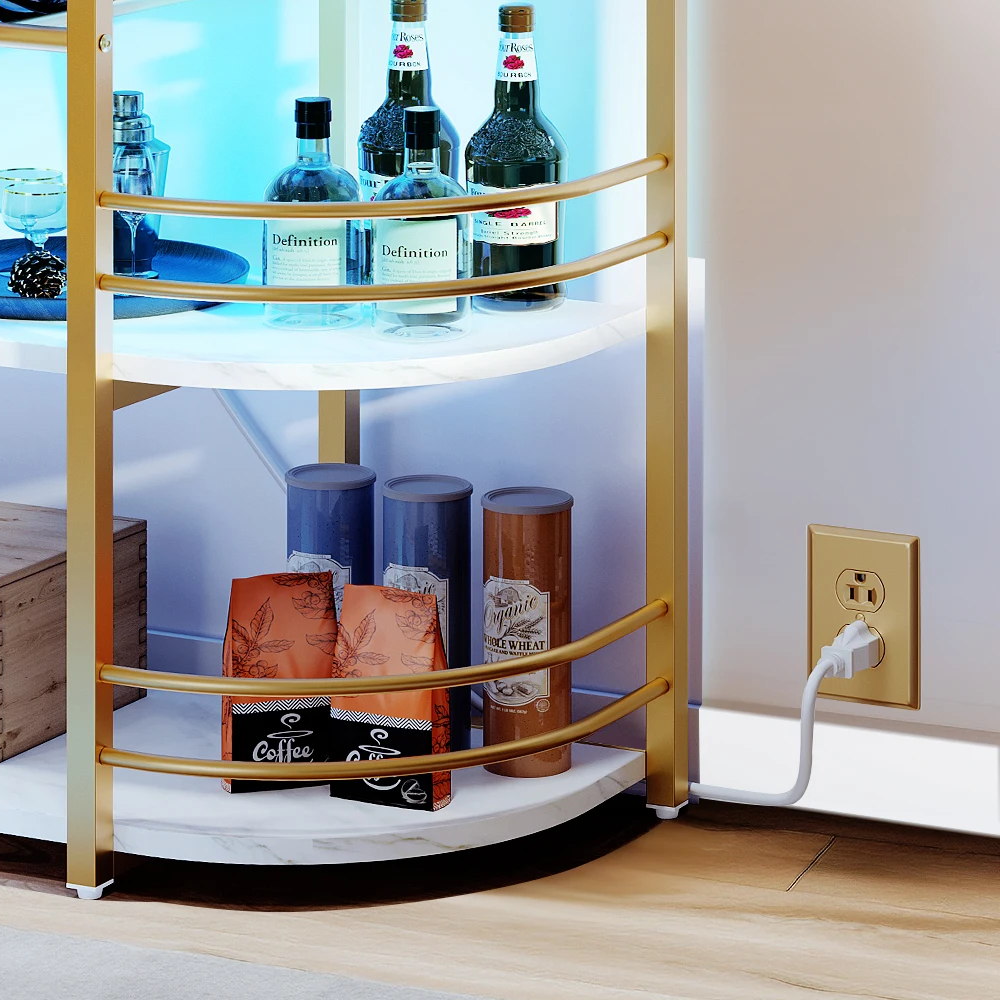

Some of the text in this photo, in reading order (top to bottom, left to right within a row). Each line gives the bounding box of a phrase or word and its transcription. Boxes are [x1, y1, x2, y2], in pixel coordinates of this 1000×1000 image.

[400, 31, 424, 42] Roses
[510, 42, 534, 53] Roses
[272, 233, 338, 247] Definition
[382, 244, 448, 258] Definition
[484, 595, 537, 631] Organic
[508, 640, 546, 650] WHEAT
[252, 738, 315, 763] Coffee
